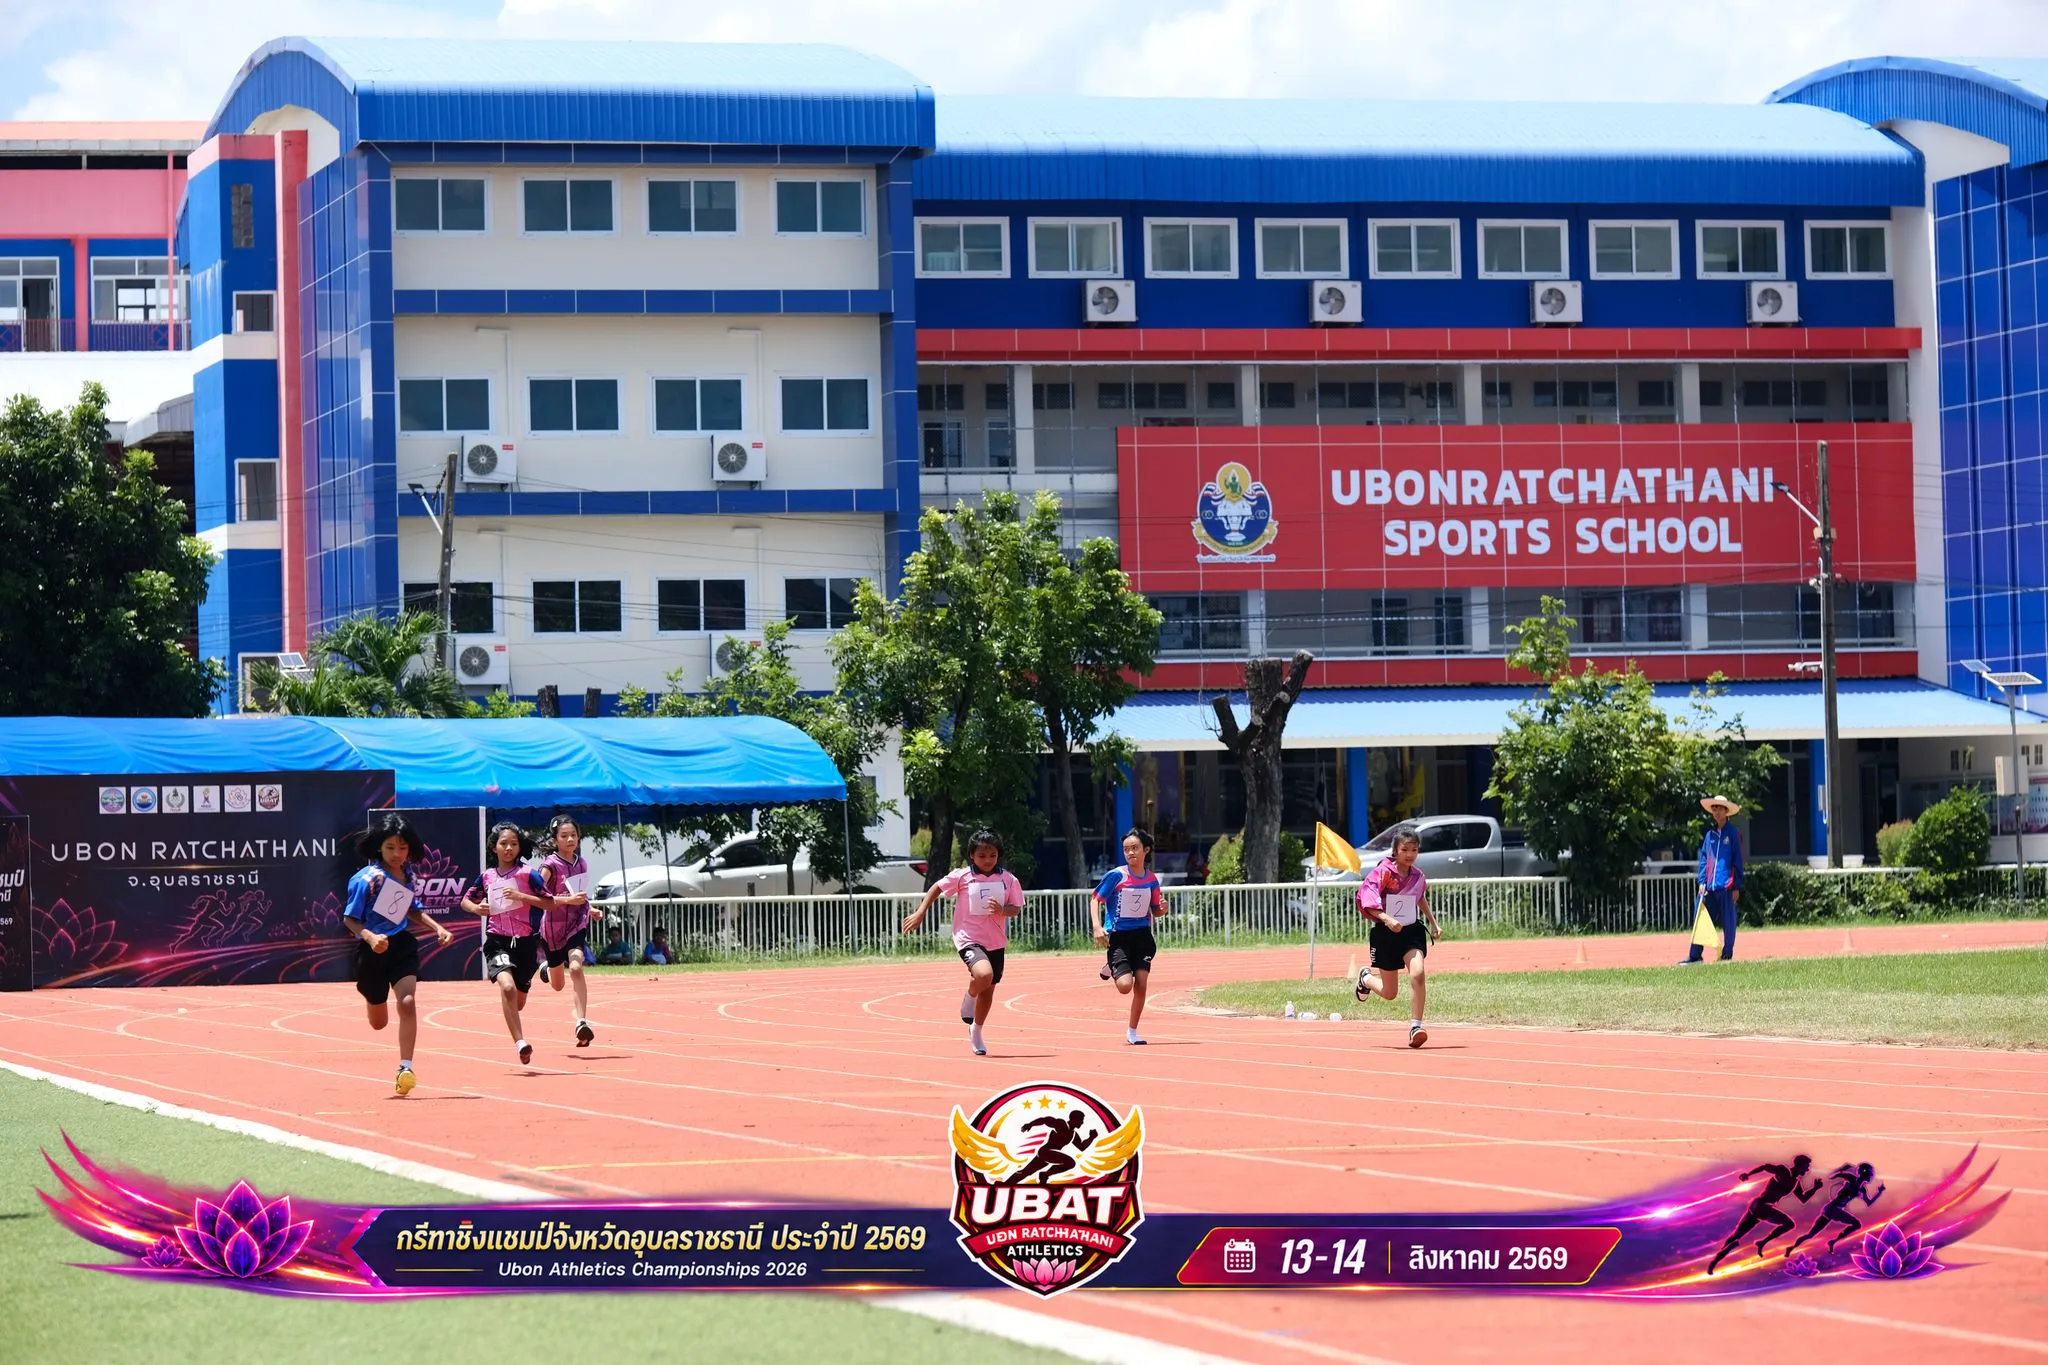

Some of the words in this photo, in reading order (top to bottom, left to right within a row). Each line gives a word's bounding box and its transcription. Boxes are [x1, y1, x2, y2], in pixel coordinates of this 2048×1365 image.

[1331, 467, 1774, 506] UBONRATCHATHANI
[1383, 517, 1551, 556] SPORTS
[1576, 516, 1743, 554] SCHOOL
[50, 842, 137, 862] UBON
[151, 838, 336, 861] RATCHATHANI
[127, 869, 260, 892] จ.อุบลราชธานี
[415, 877, 468, 896] BON
[387, 890, 405, 915] 8
[980, 888, 991, 910] 5
[1130, 894, 1143, 913] 3
[1393, 900, 1406, 918] 2
